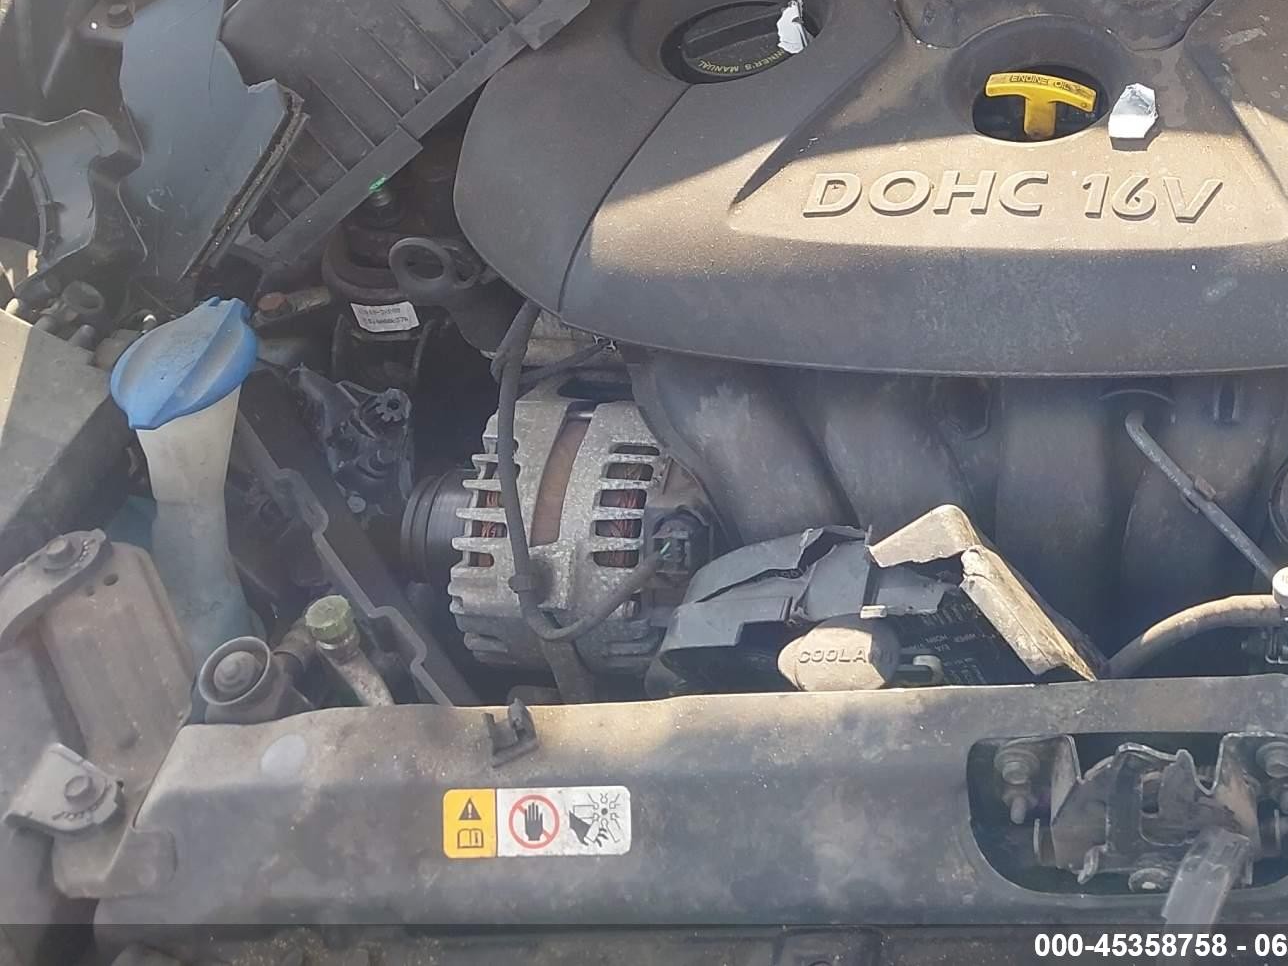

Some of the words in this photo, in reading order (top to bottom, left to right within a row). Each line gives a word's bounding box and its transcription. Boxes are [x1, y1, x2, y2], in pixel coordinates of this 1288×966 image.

[698, 59, 739, 73] MANUAL
[1010, 74, 1049, 85] ENGINE
[803, 170, 1050, 218] DOHC
[1081, 172, 1225, 224] 16V
[798, 647, 888, 665] COOLA
